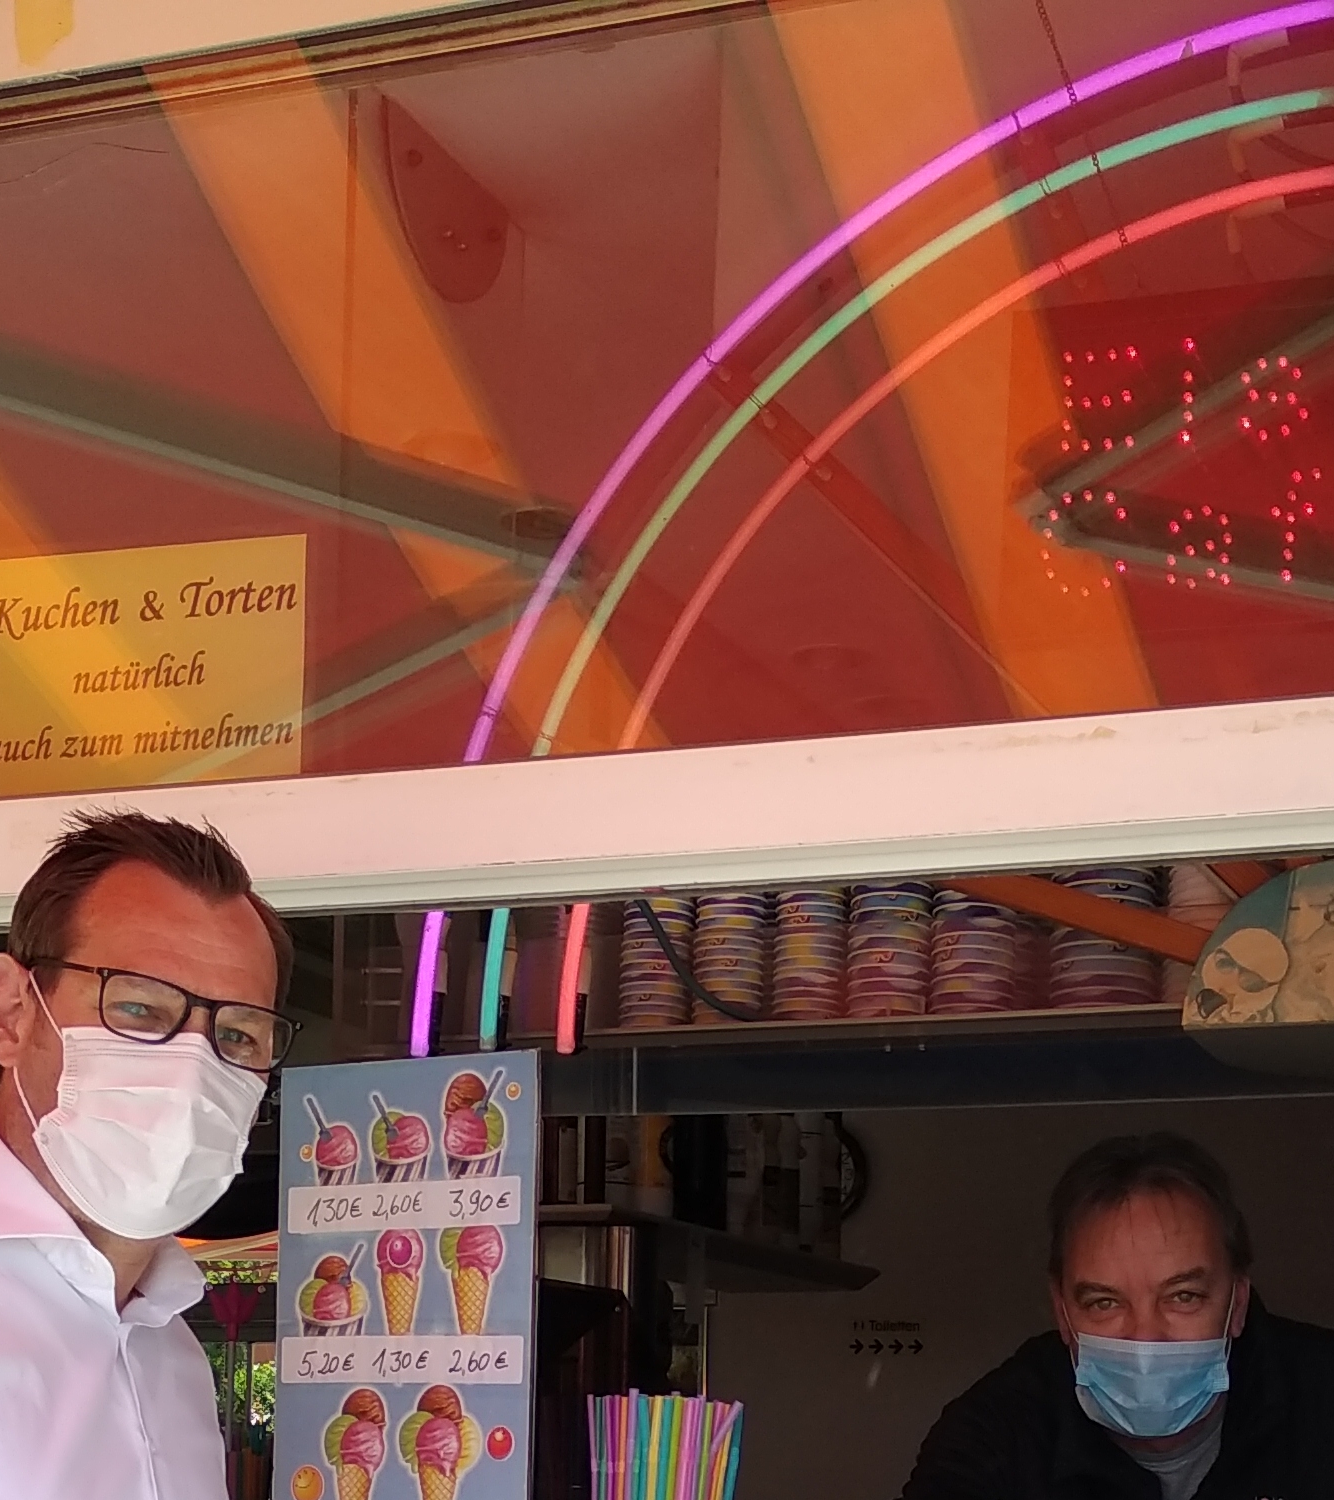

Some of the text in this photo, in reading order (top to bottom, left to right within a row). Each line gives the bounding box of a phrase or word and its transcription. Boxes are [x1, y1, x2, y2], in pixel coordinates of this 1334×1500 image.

[139, 590, 166, 623] &
[179, 577, 298, 620] Torten
[72, 650, 206, 695] natürlich
[59, 732, 124, 760] zum
[133, 713, 294, 753] mitnehmen
